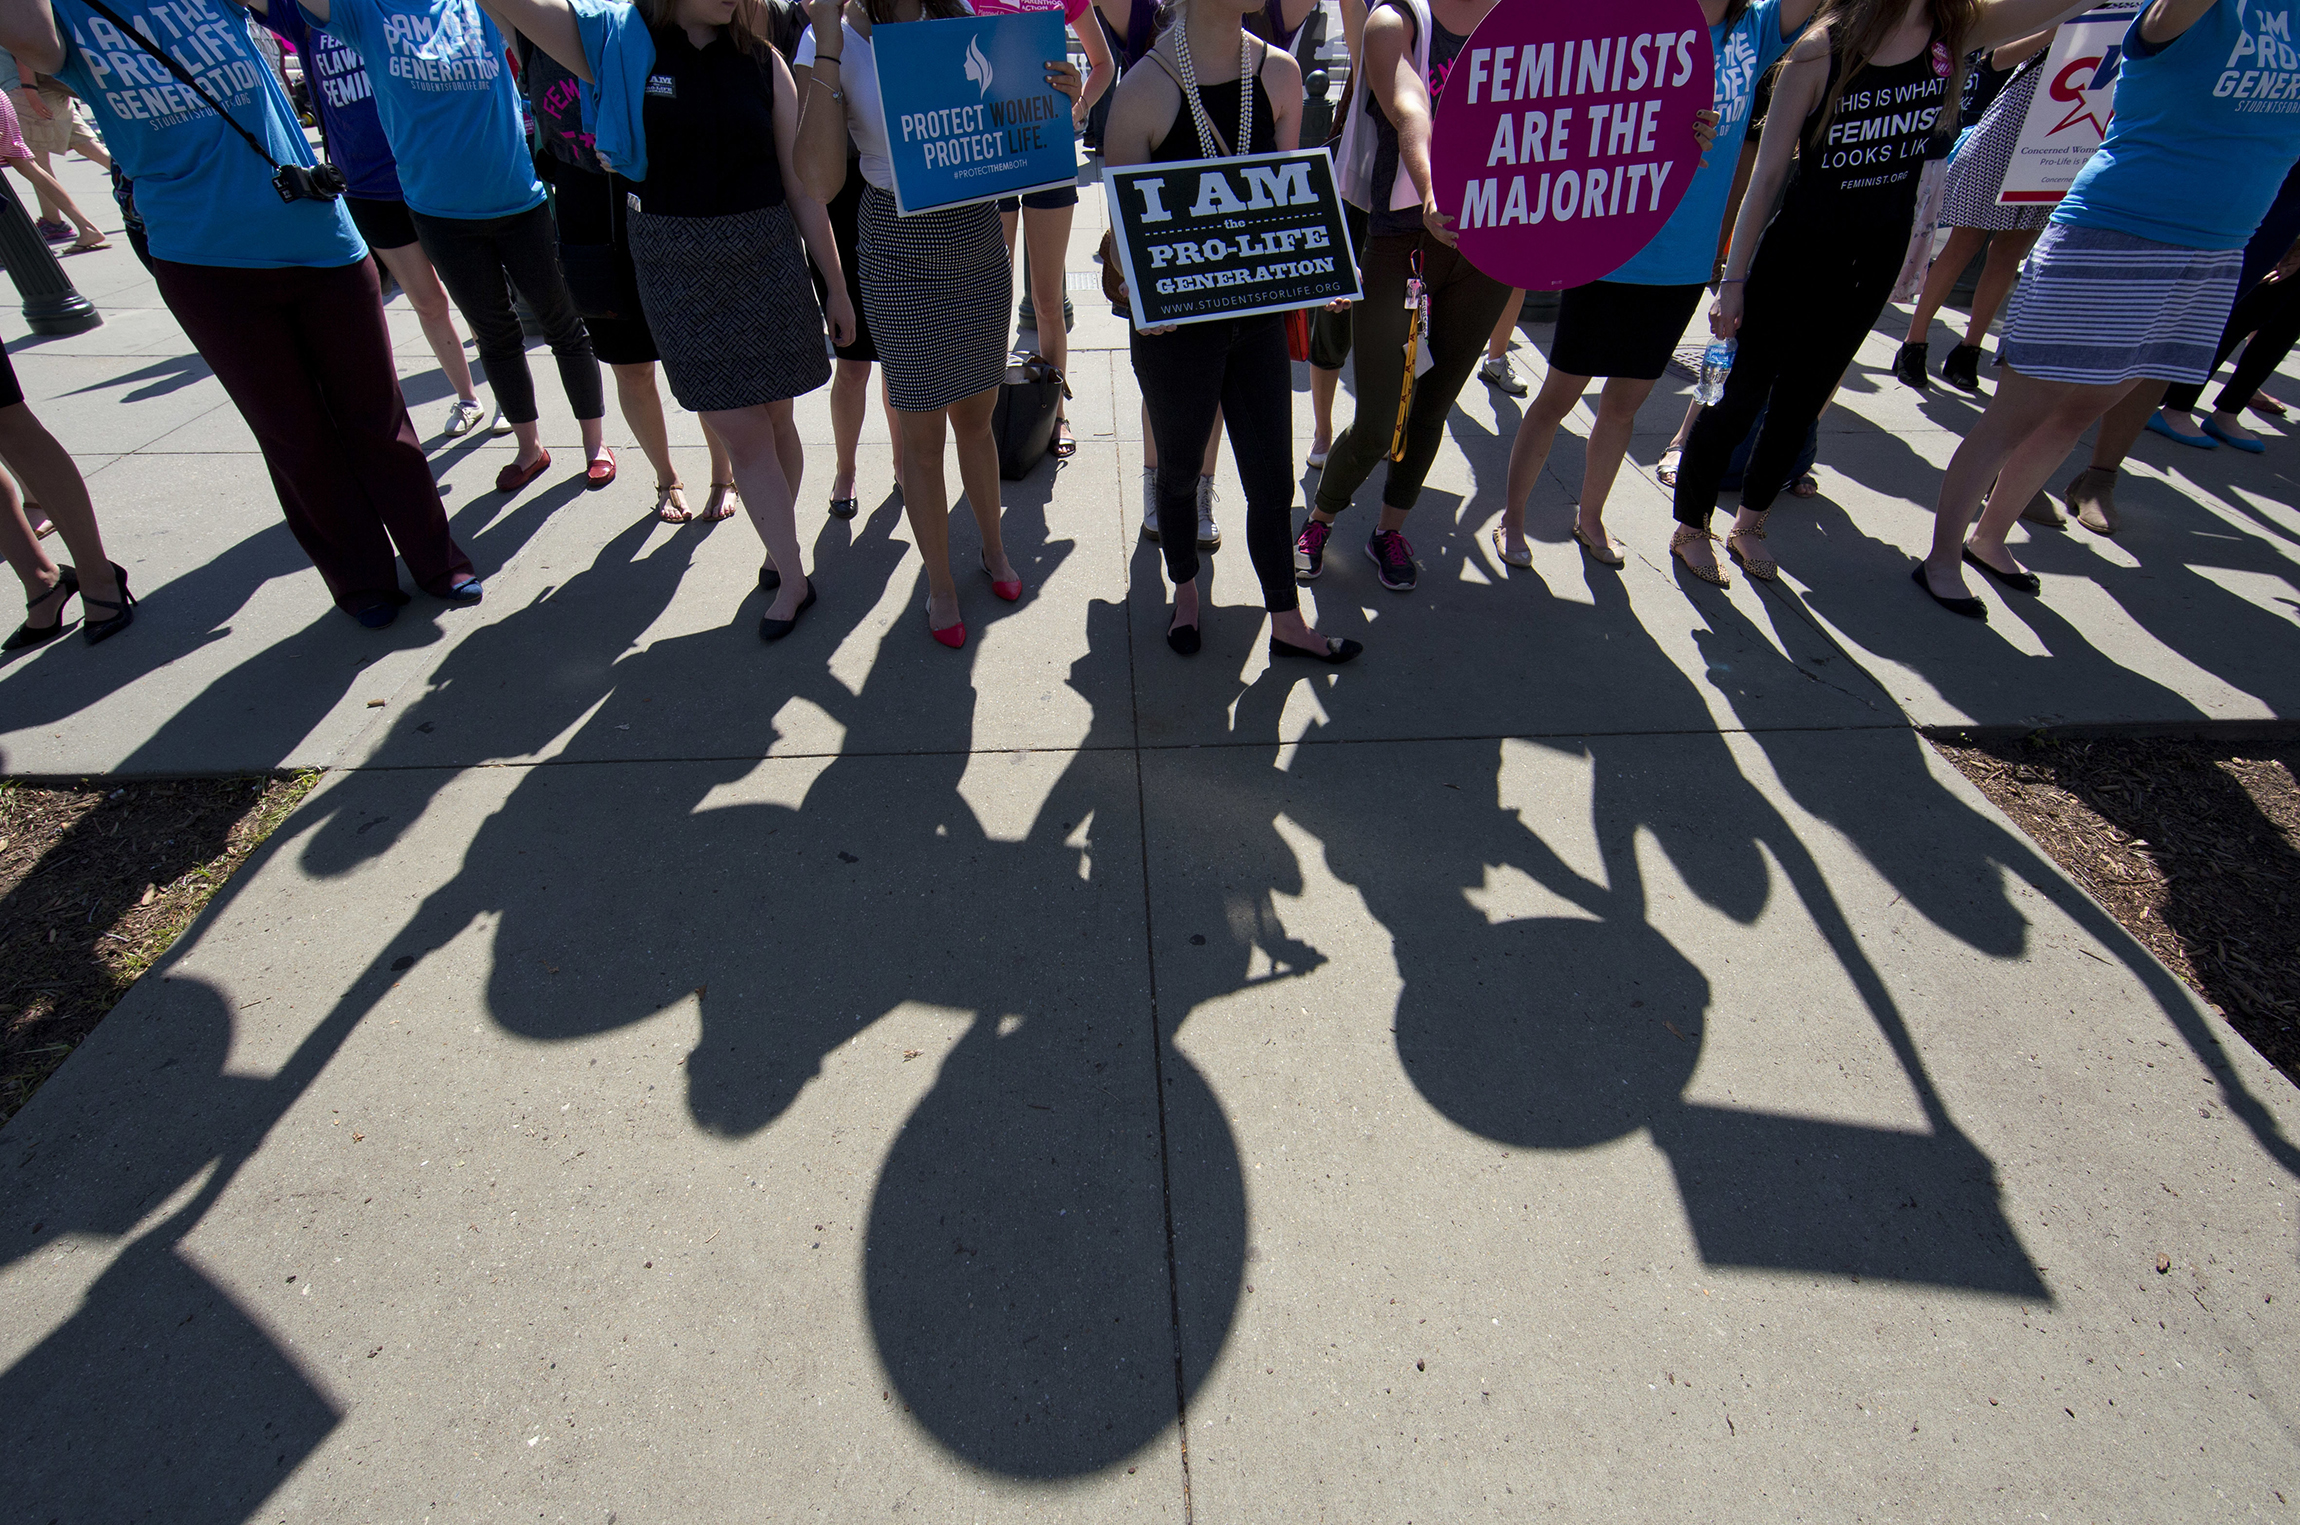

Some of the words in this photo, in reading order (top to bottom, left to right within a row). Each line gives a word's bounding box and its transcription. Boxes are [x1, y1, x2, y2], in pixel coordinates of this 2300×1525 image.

[88, 16, 161, 51] AM
[148, 0, 221, 40] THE
[391, 13, 435, 43] AM
[1467, 29, 1697, 105] FEMINISTS
[1715, 31, 1755, 71] HE
[2225, 29, 2300, 70] PRO
[389, 56, 500, 82] GENERATION
[411, 80, 490, 93] STUDENTSFORLIFE.ORG
[2212, 70, 2300, 100] GENER
[105, 60, 263, 120] GENERATION
[322, 70, 373, 108] FEMIN
[543, 78, 581, 120] FEM
[1875, 88, 1892, 108] IS
[1894, 77, 1945, 104] WHAT
[2234, 100, 2300, 114] STUDENTSFOR
[149, 91, 252, 132] STUDENTSFORIFE.ORG
[901, 104, 984, 143] PROTECT
[989, 94, 1060, 128] WOMEN.
[923, 131, 1003, 170] PROTECT
[1007, 125, 1048, 155] LIFE.
[1486, 107, 1573, 167] ARE
[1588, 99, 1662, 158] THE
[2020, 145, 2070, 155] Concerned
[953, 158, 1029, 180] #PROTECTTHEMBOTH
[1821, 144, 1892, 169] LOOKS
[1899, 137, 1930, 159] LIK
[2040, 157, 2072, 166] Pro-Life
[1133, 177, 1173, 224] I
[1188, 162, 1319, 218] AM
[1459, 161, 1674, 230] MAJORITY
[1840, 170, 1909, 190] FEMINIST.ORG
[1223, 218, 1247, 230] the
[1147, 225, 1331, 269] PRO-LIFE
[1155, 256, 1335, 295] GENERATION
[1160, 281, 1341, 316] WWW.STUDENTSFORLIFE.ORG
